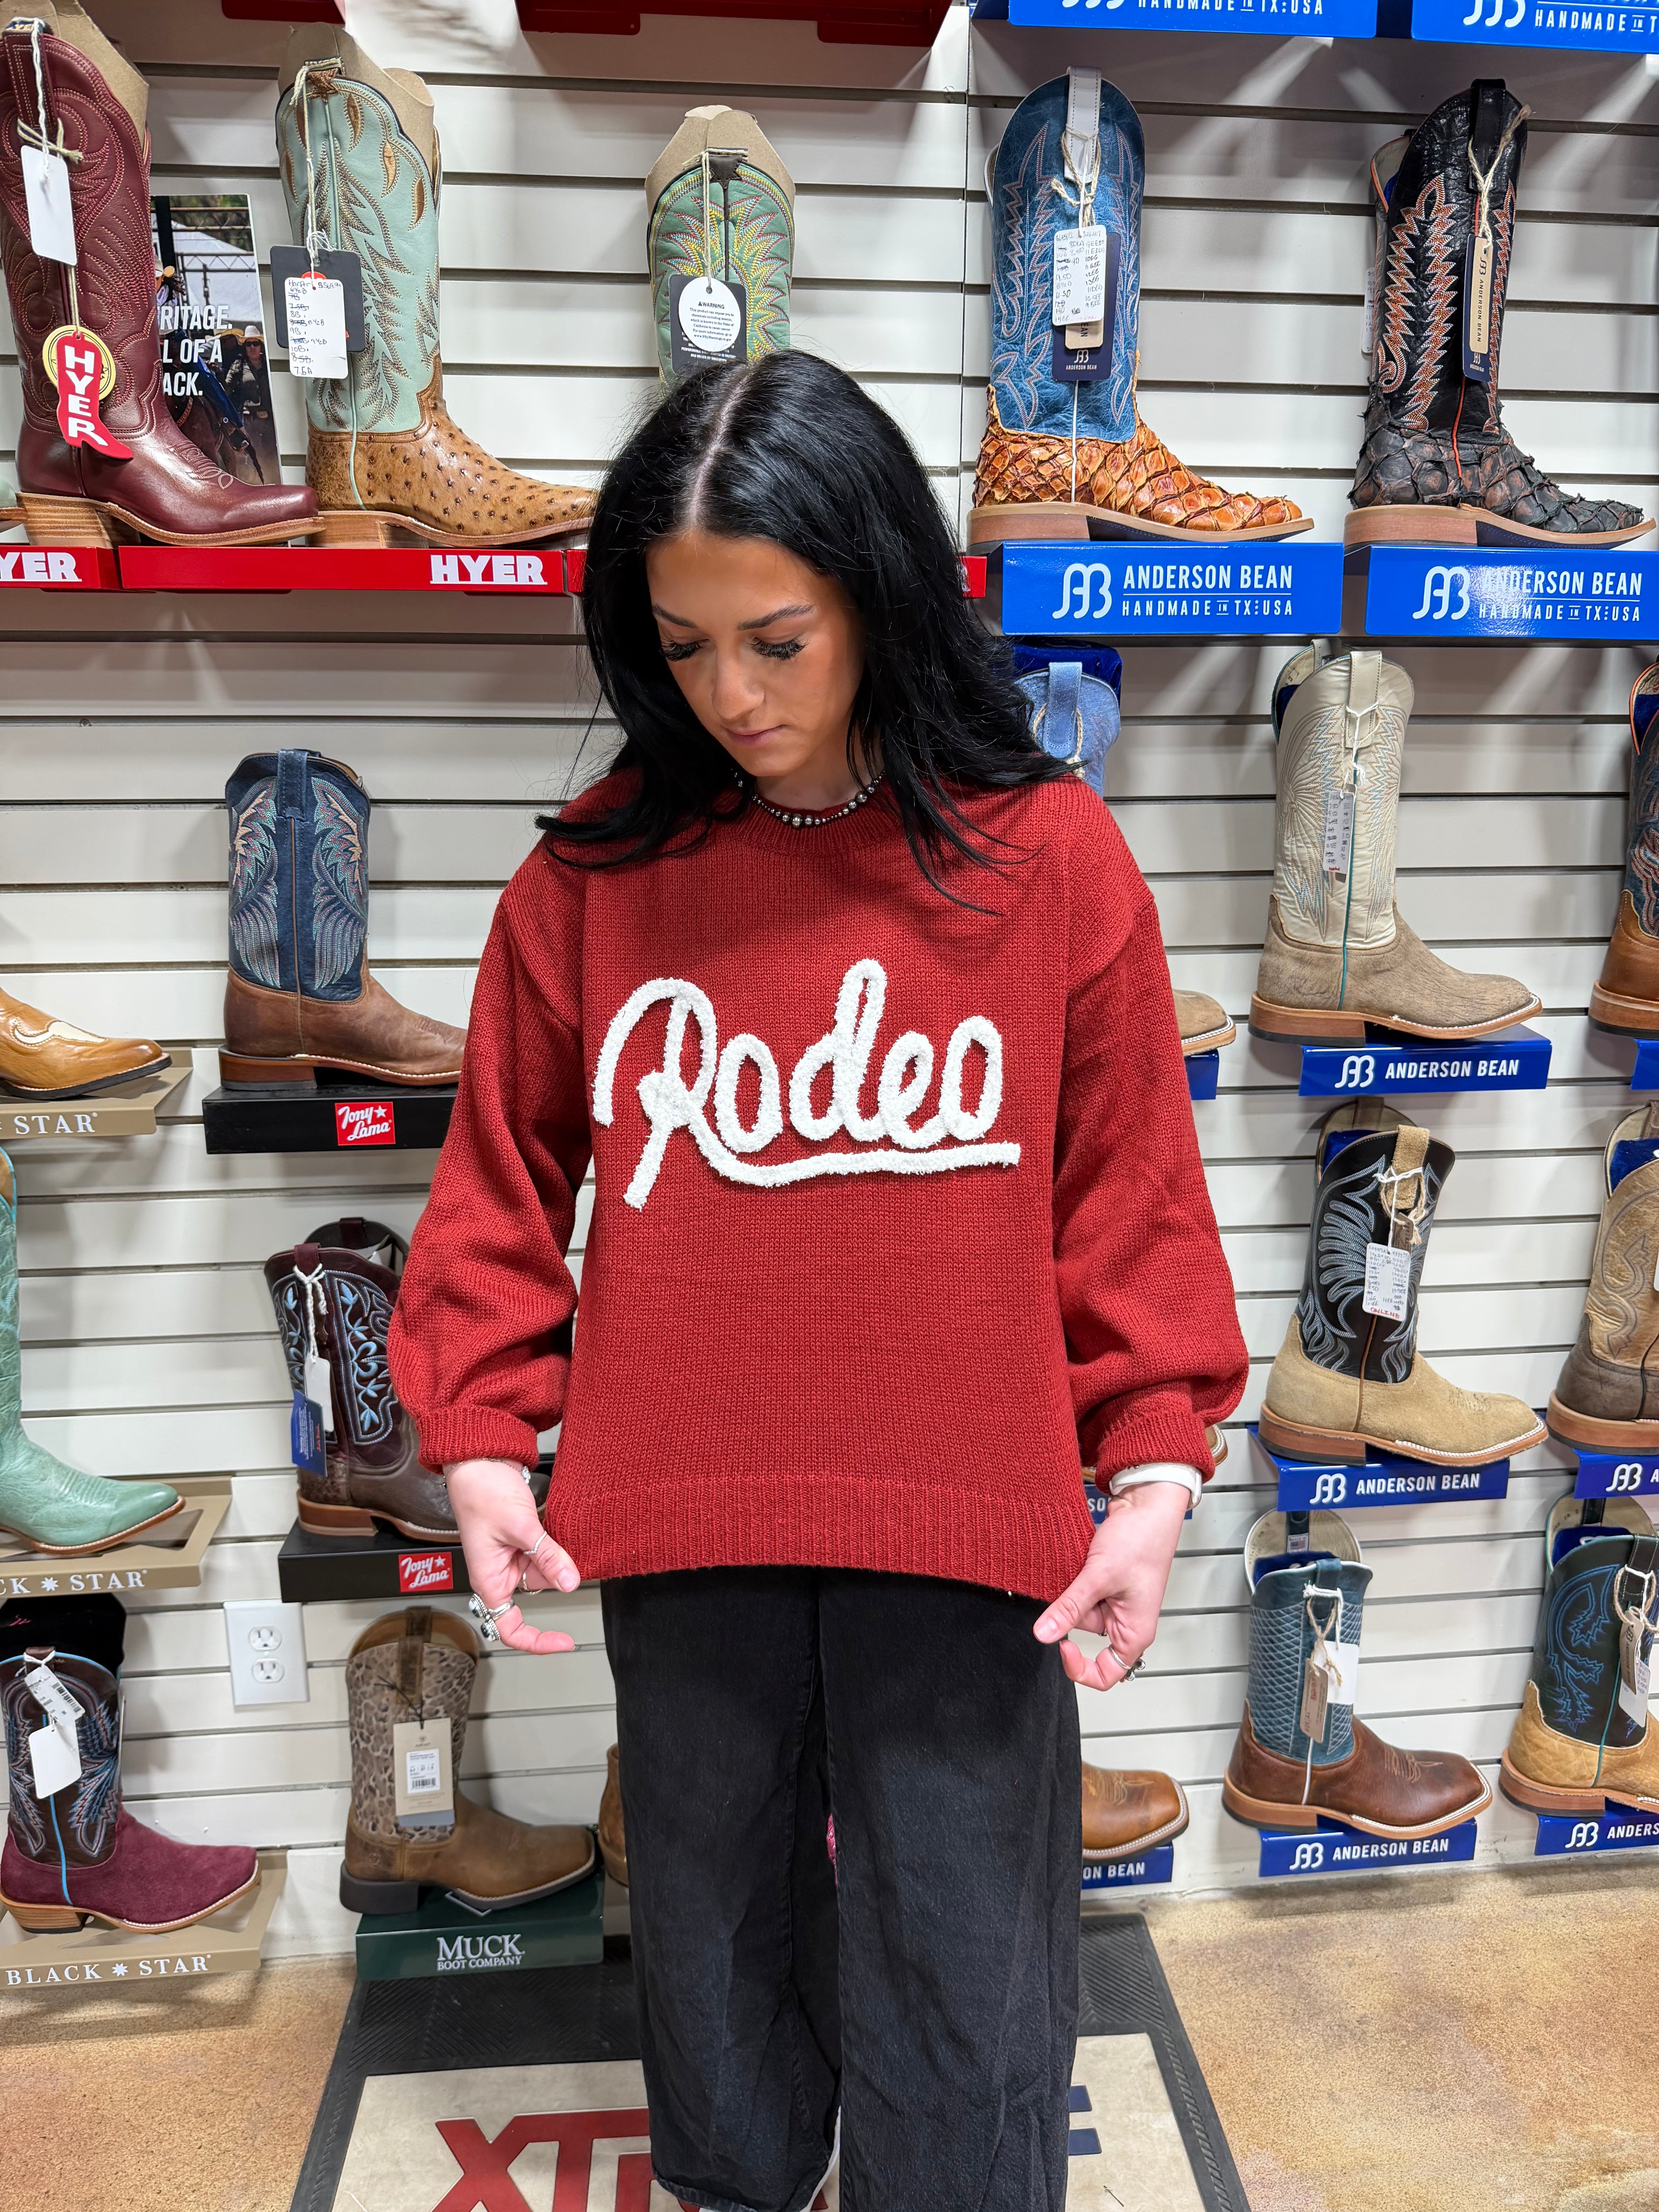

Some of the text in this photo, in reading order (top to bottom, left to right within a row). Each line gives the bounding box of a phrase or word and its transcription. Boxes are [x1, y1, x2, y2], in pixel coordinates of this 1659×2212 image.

[1291, 0, 1322, 14] USA
[1535, 9, 1626, 32] HANDMADE
[1650, 16, 1657, 32] T
[158, 305, 232, 330] RITAGE.
[1081, 323, 1089, 337] EAN
[163, 339, 222, 363] L OF A
[64, 344, 108, 446] HYER
[163, 372, 203, 396] ACK.
[0, 552, 83, 582] YER
[430, 555, 548, 585] HYER
[1123, 566, 1292, 589] ANDERSON BEAN
[1481, 568, 1642, 595] ANDERSON BEAN
[1122, 600, 1211, 616] HANDMADE
[1234, 600, 1250, 615] TX
[1263, 600, 1292, 615] USA
[1478, 604, 1563, 620] HANDMADE
[1586, 606, 1601, 620] TX
[1612, 606, 1639, 621] USA
[1385, 1059, 1519, 1079] ANDERSON BEAN
[593, 958, 1021, 1211] Rodeo
[14, 1114, 95, 1135] STAR
[337, 1106, 374, 1129] Tony
[346, 1120, 391, 1141] Lama
[1370, 1307, 1399, 1318] ONLINE
[1356, 1473, 1480, 1495] ANDERSON BEAN
[400, 1557, 434, 1579] Tony
[408, 1569, 449, 1589] Lama
[70, 1571, 145, 1592] STAR
[1607, 1822, 1659, 1839] ANDERS
[1332, 1838, 1449, 1861] ANDERSON BEAN
[1083, 1862, 1145, 1879] ON BEAN
[436, 1934, 523, 1961] MUCK
[6, 1956, 209, 1986] BLACK STAR
[437, 1955, 522, 1971] BOOT COMPANY
